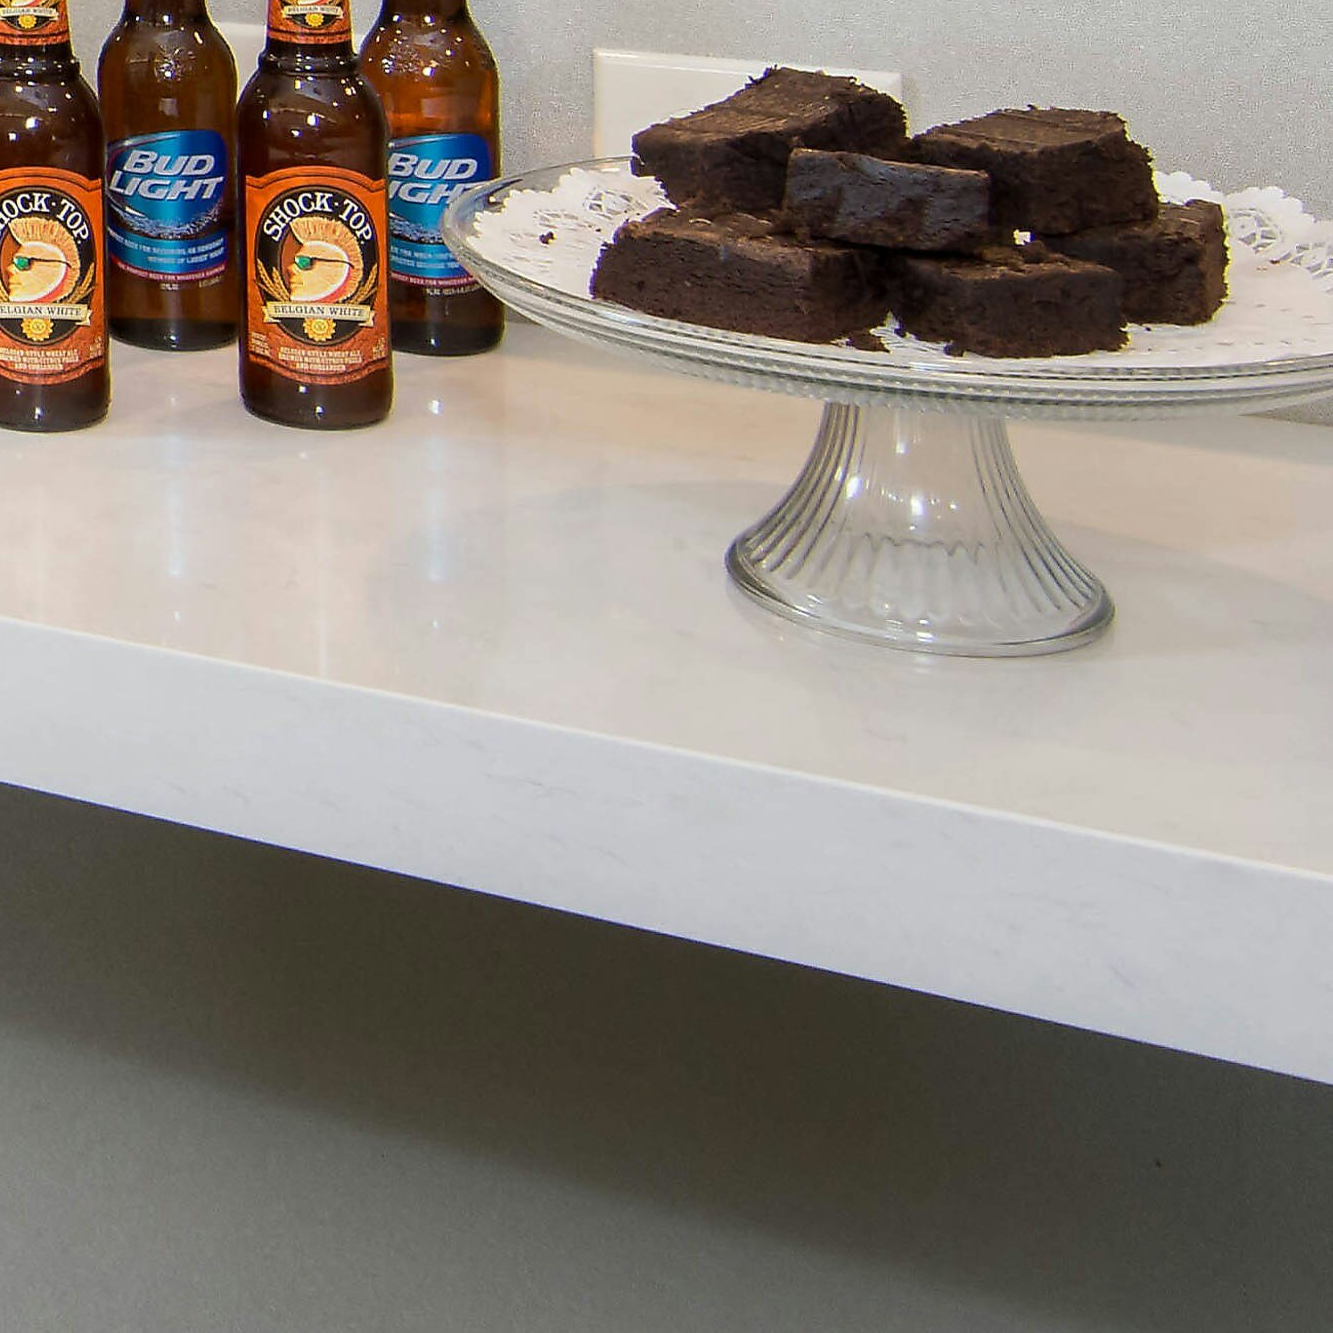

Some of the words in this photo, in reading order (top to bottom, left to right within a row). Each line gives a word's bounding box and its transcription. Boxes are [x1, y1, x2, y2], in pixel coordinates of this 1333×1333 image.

[122, 150, 215, 176] BUD
[388, 152, 477, 179] BUD
[109, 172, 224, 201] LIGHT
[388, 180, 471, 204] IGH
[263, 191, 333, 242] SHOCK
[46, 306, 82, 316] WHITE
[273, 305, 325, 315] BELGIAN
[328, 306, 366, 317] WHITE
